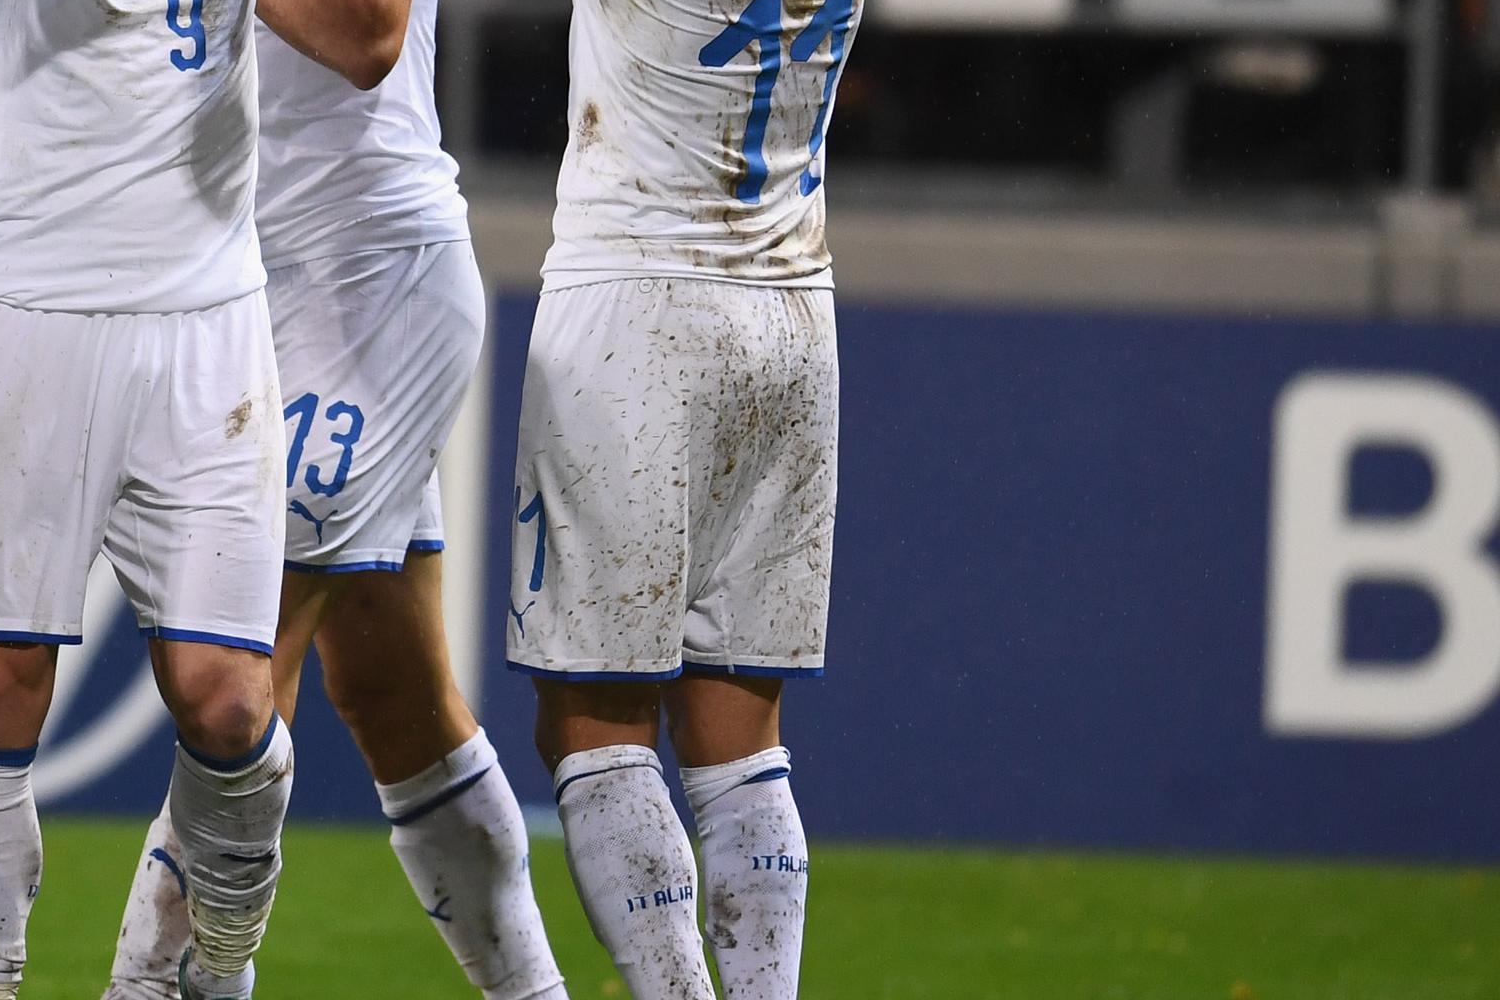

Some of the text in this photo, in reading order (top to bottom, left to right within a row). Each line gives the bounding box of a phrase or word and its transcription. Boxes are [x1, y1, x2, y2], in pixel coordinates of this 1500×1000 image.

[285, 391, 365, 499] 13
[515, 485, 547, 592] 1
[752, 854, 809, 875] ITALIA
[626, 885, 694, 914] ITALIA
